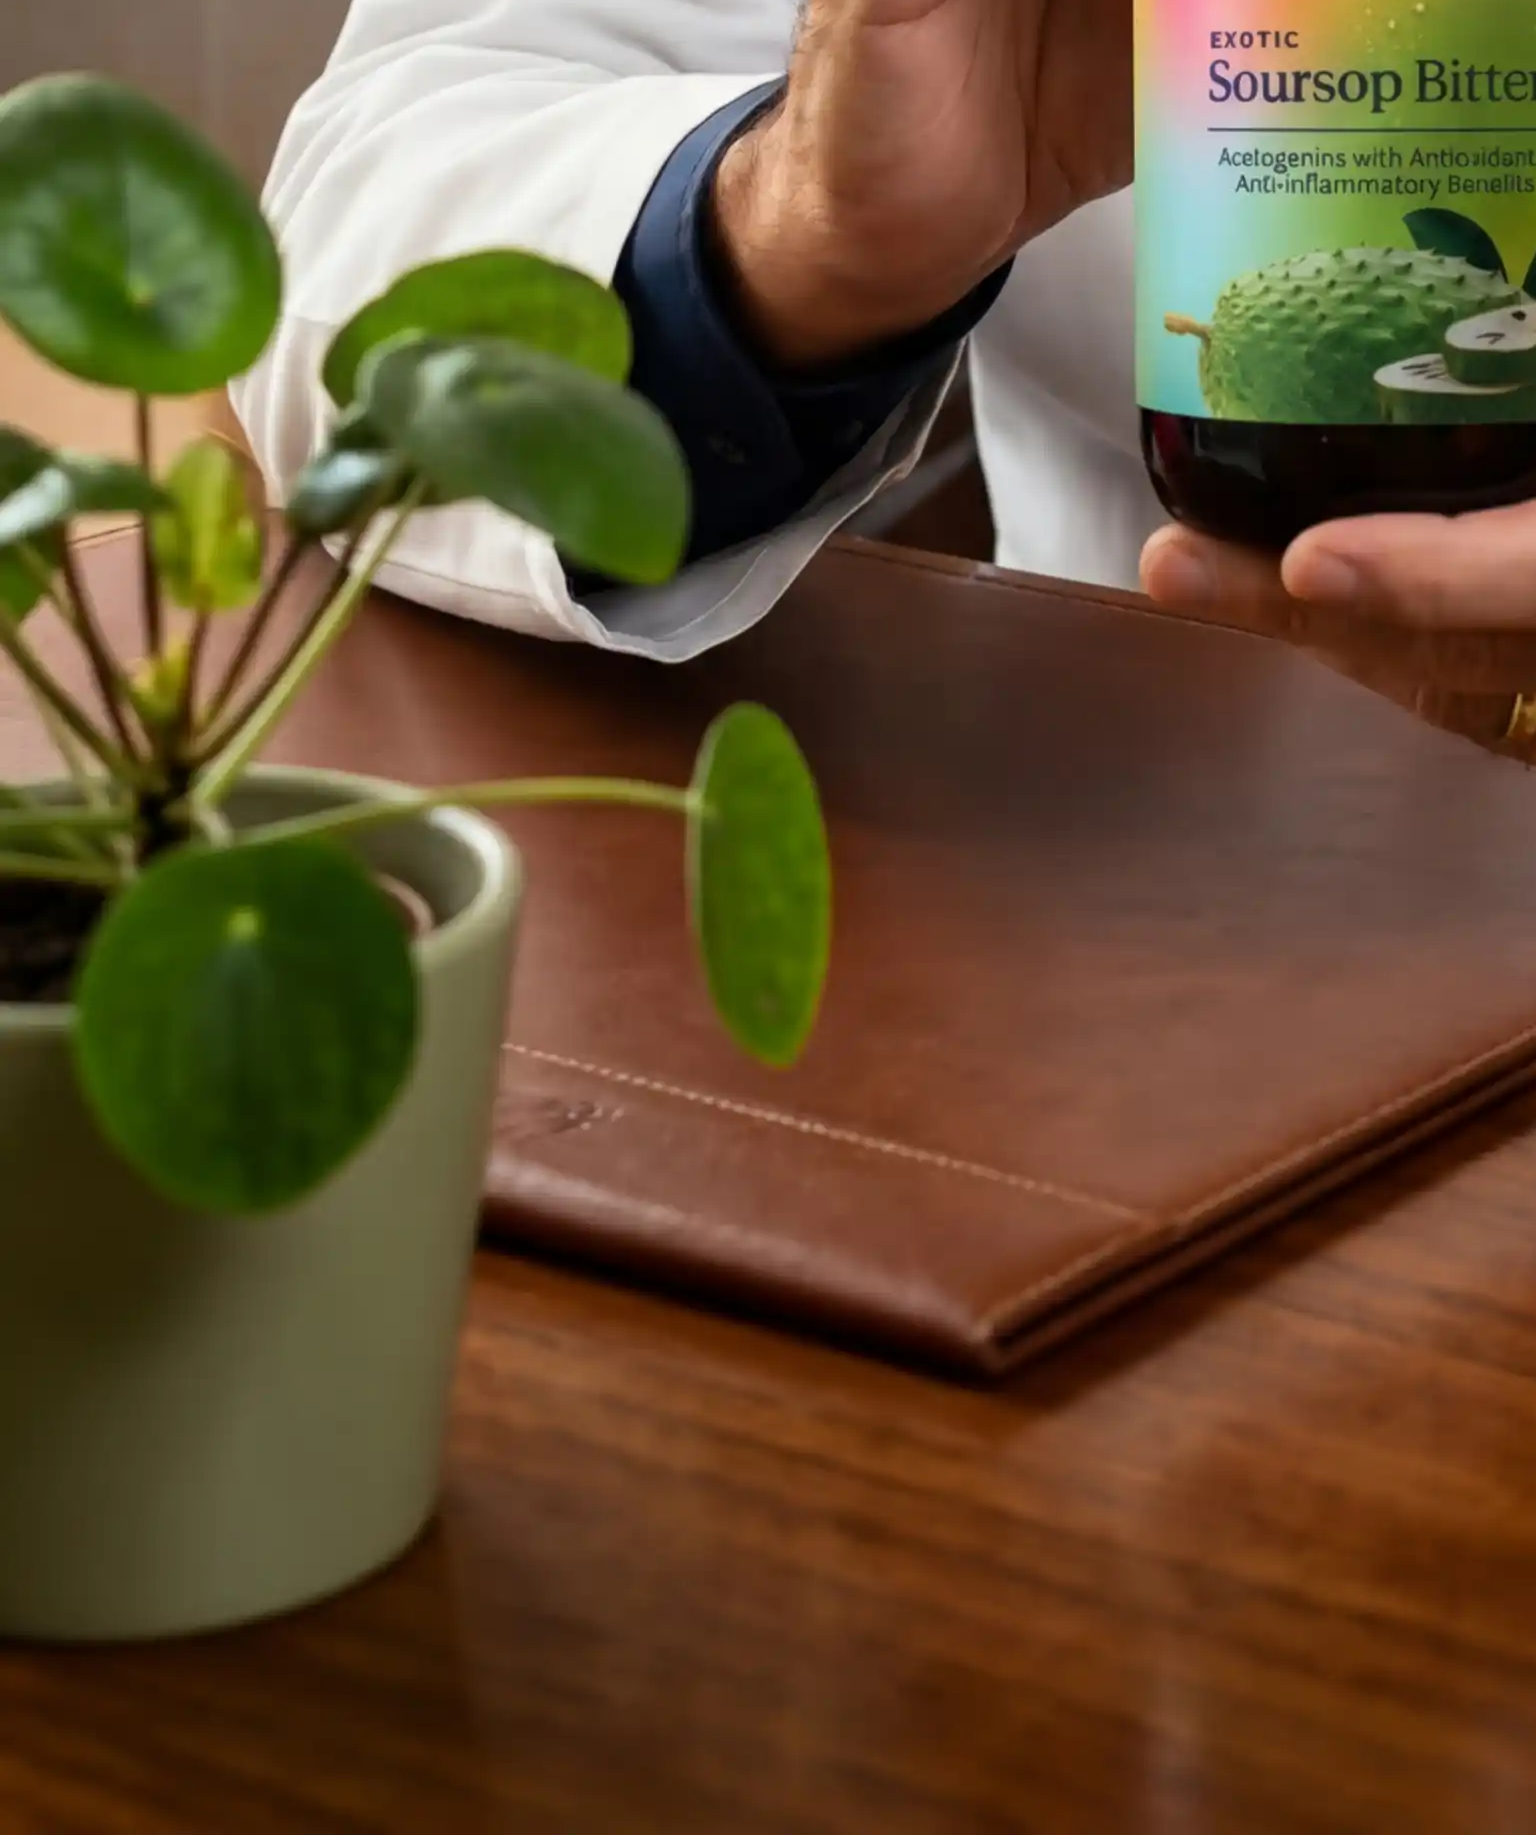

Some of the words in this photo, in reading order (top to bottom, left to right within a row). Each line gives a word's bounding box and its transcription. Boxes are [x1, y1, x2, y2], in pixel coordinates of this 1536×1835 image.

[1210, 30, 1300, 49] EXOTIC
[1208, 59, 1402, 113] Soursop
[1218, 147, 1347, 175] Acetogenins
[1352, 146, 1402, 169] with
[1235, 174, 1440, 202] Anti-inflammatory
